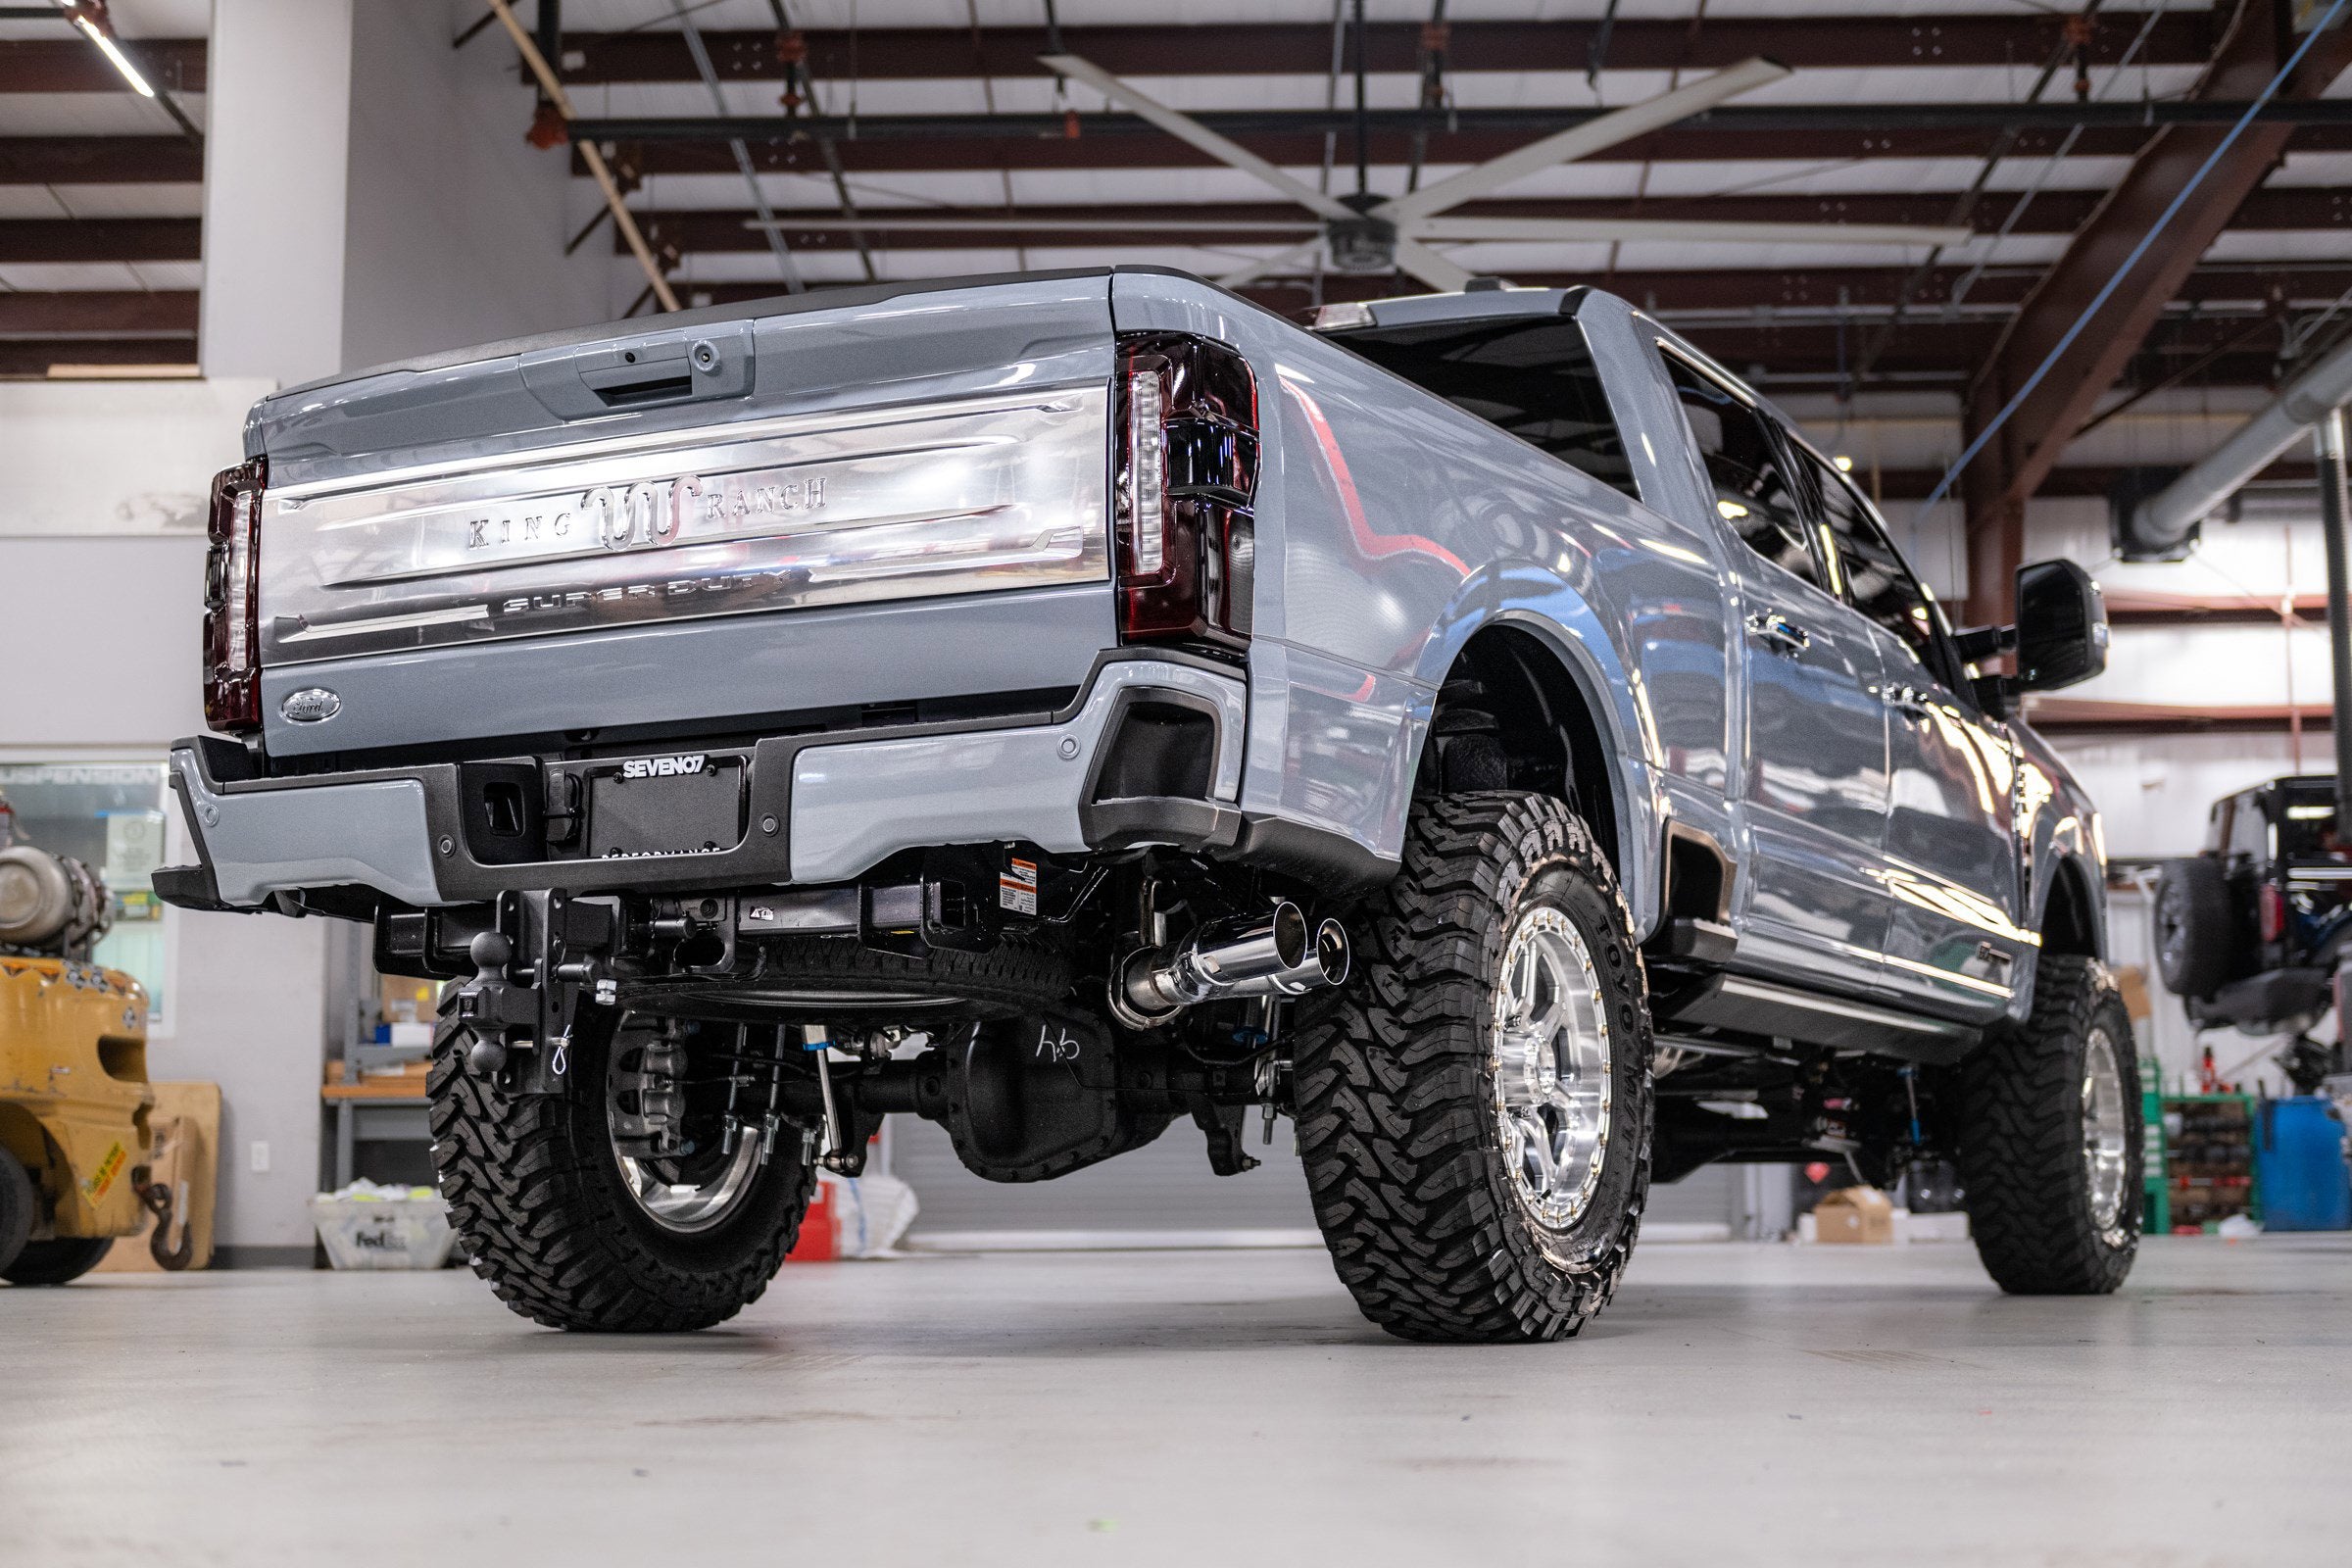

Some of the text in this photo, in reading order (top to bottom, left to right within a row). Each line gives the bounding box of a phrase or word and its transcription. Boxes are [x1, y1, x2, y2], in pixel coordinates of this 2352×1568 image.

[706, 476, 827, 519] RANCH
[468, 512, 572, 549] KING
[503, 568, 792, 615] SUPER DUTY
[1595, 913, 1635, 1036] TOYO
